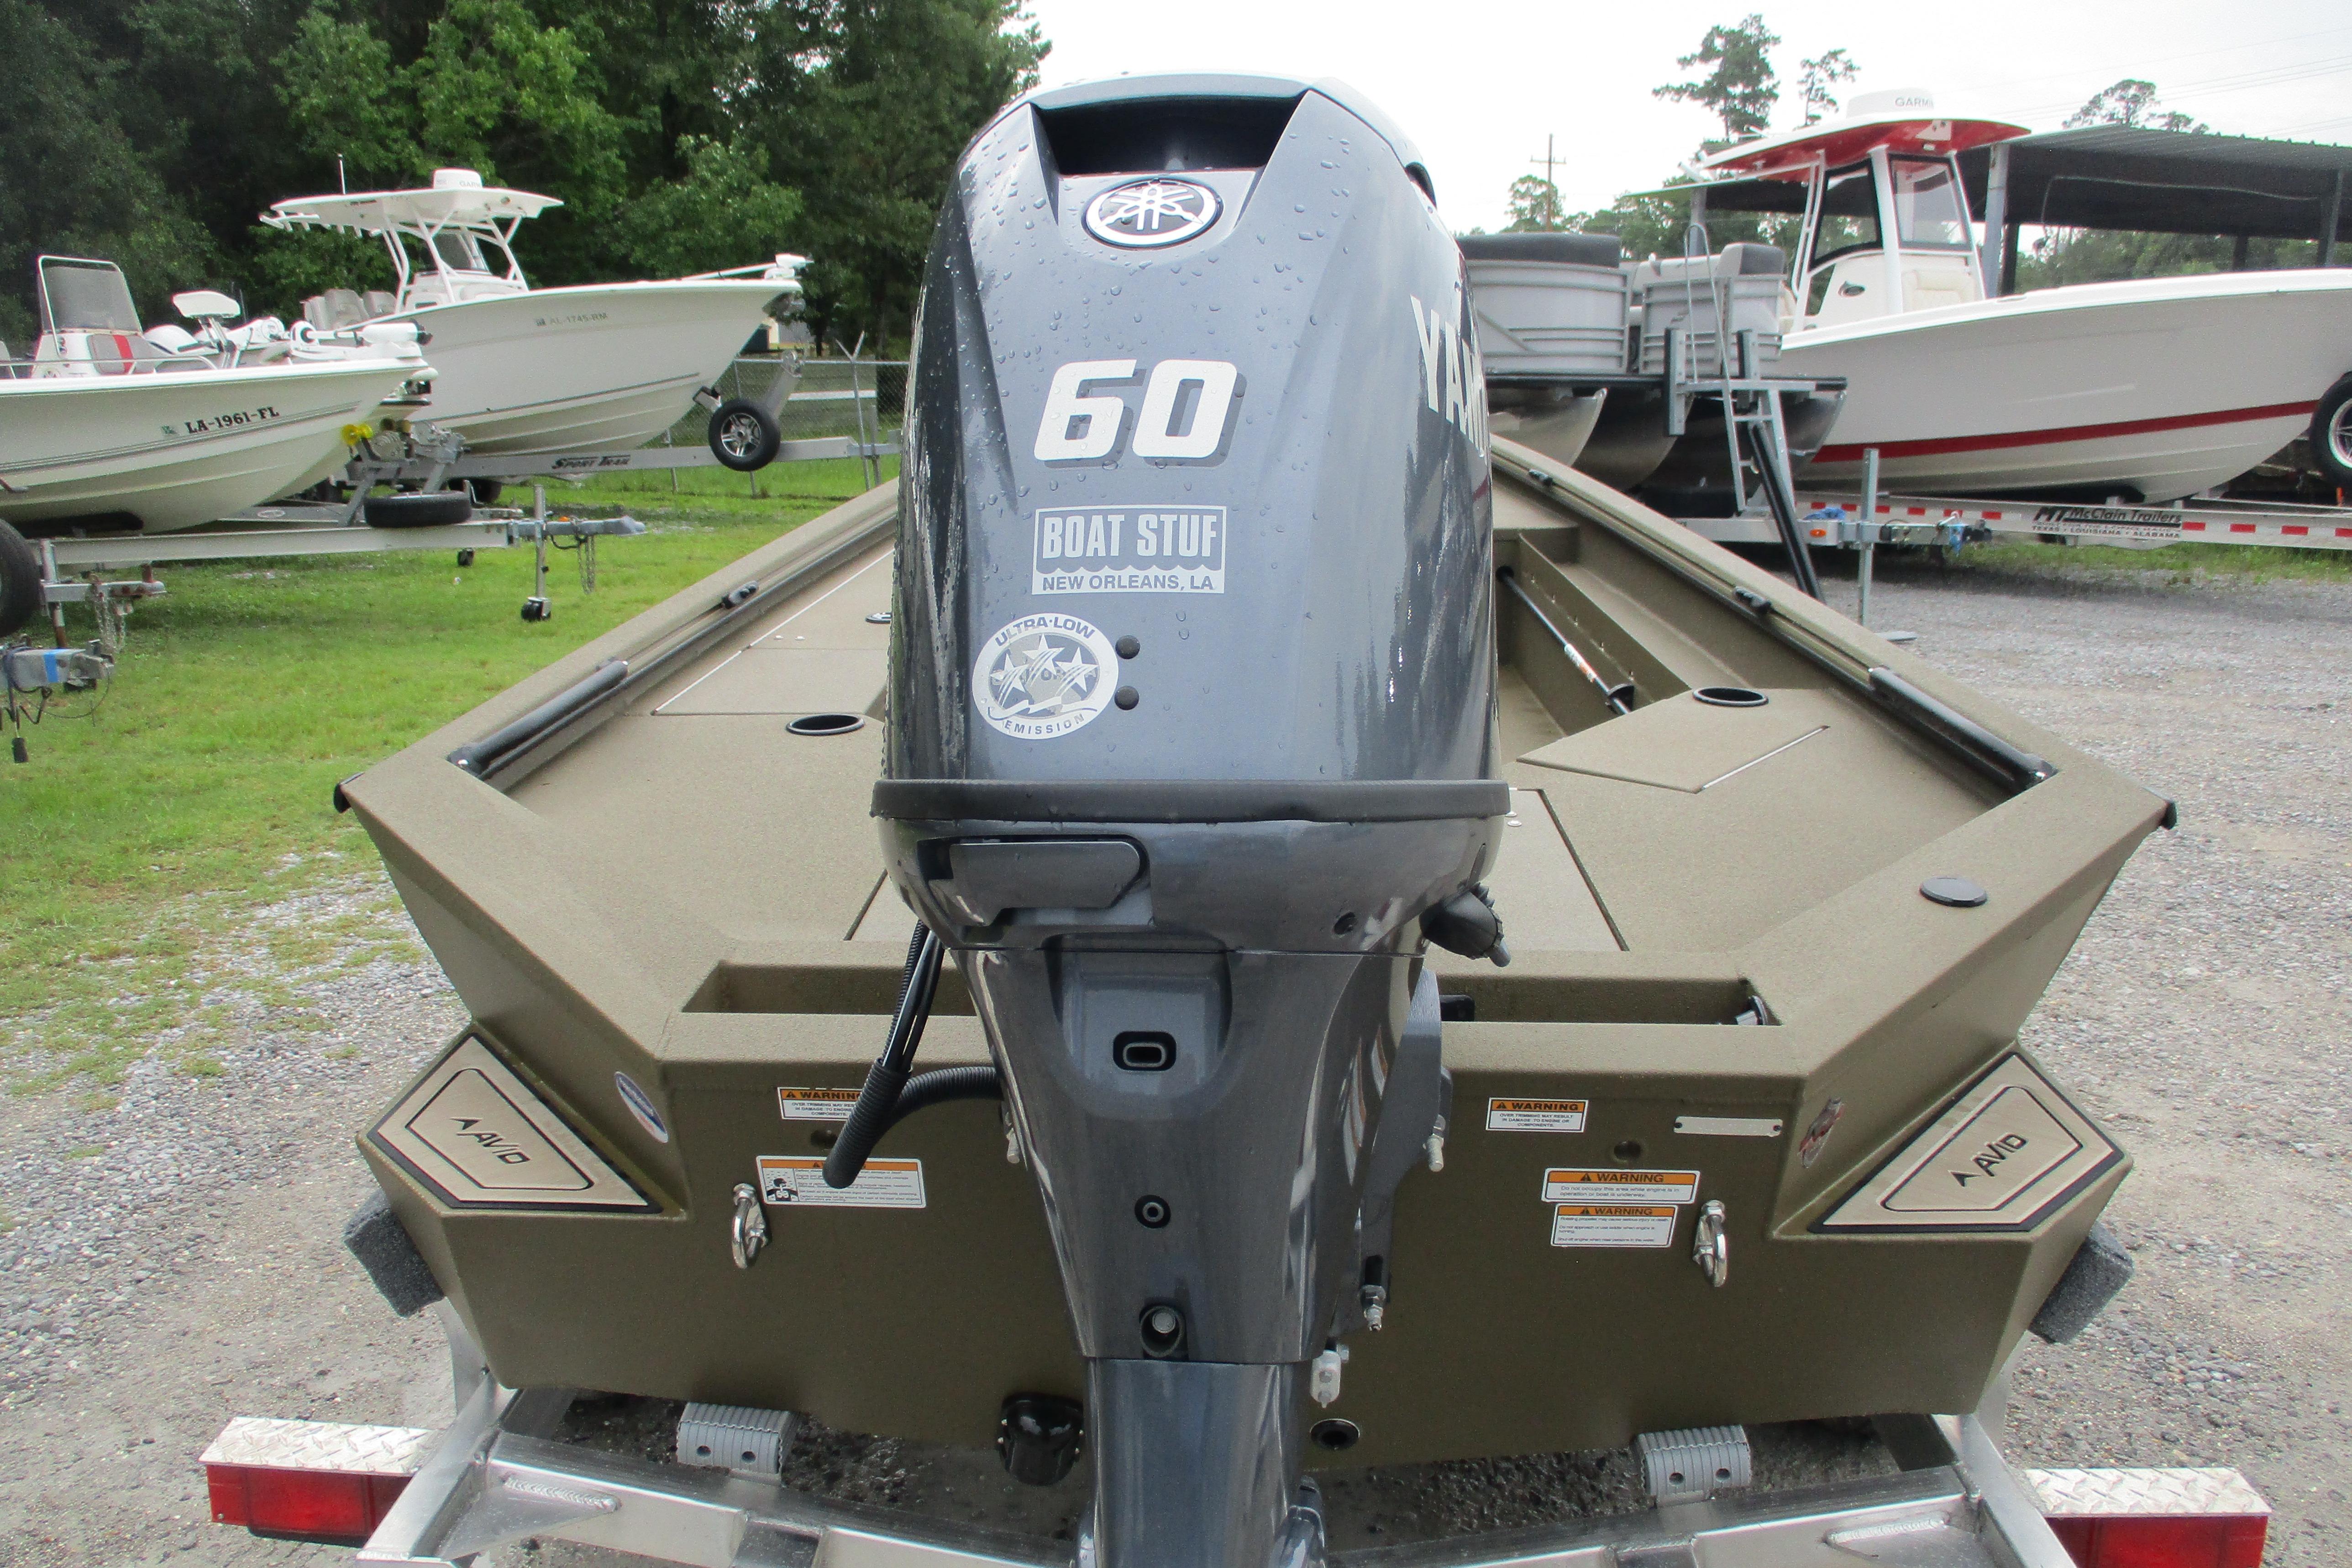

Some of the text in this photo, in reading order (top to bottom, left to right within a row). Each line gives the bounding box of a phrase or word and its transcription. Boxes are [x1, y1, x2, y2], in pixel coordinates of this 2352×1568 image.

[1410, 293, 1486, 457] YAM
[184, 405, 280, 434] LA-1961-FL
[1034, 359, 1239, 462] 60
[2068, 507, 2126, 519] McClain
[2131, 509, 2181, 522] Trailers
[1042, 514, 1217, 559] BOAT STUF
[1042, 575, 1214, 592] NEW ORLEANS, LA
[1003, 713, 1085, 735] EMISSION
[1512, 1102, 1579, 1111] WARNING
[457, 1133, 531, 1164] AVID
[1973, 1133, 2027, 1177] AVID
[1597, 1174, 1664, 1183] WARNING
